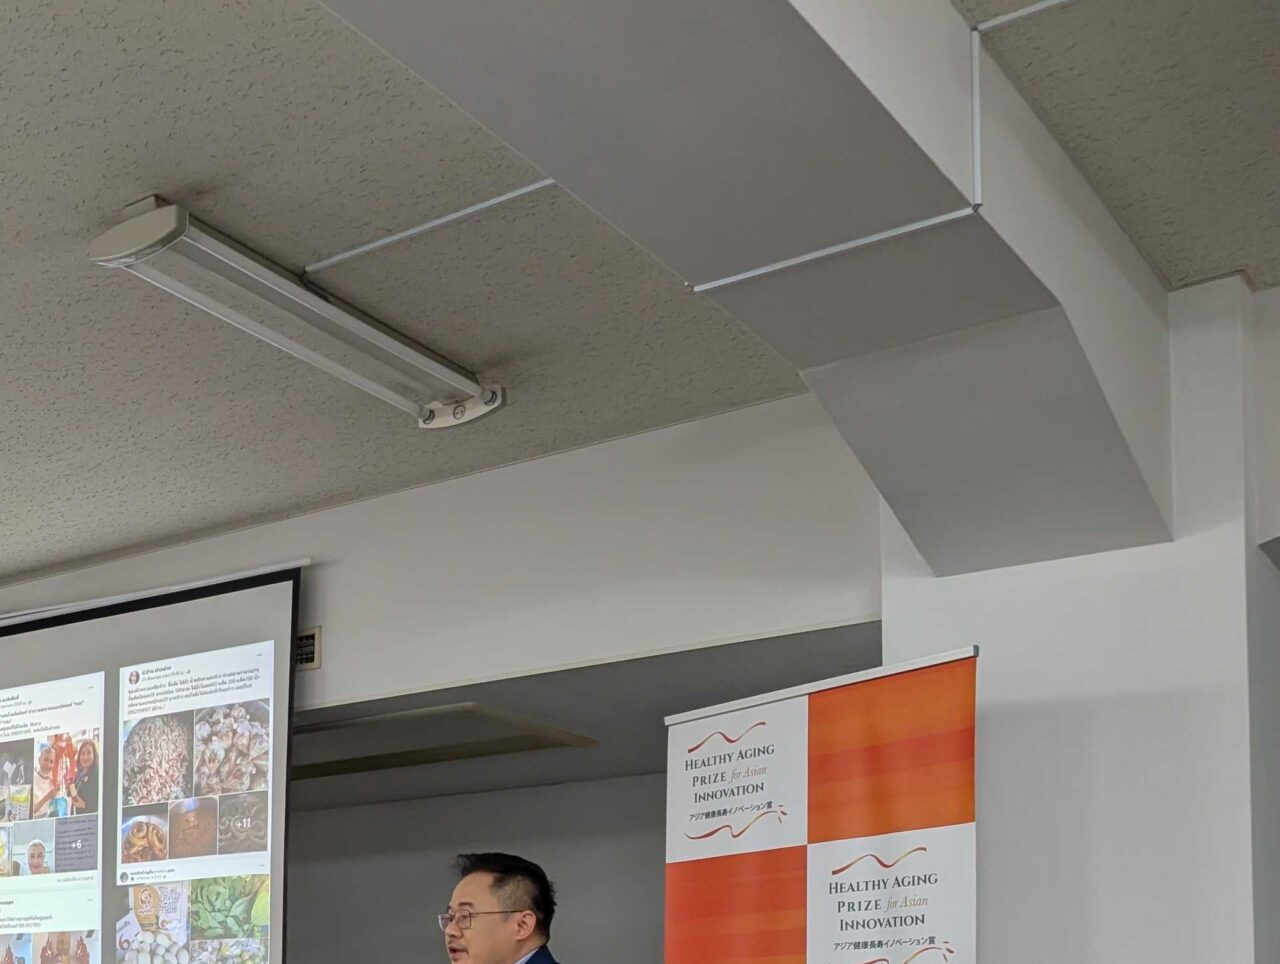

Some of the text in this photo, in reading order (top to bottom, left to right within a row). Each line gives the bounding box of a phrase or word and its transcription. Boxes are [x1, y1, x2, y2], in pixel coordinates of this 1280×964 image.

[685, 744, 775, 771] HEALTHY AGING
[692, 766, 767, 787] PRIZE for Asian
[694, 782, 764, 804] INNOVATION
[688, 801, 773, 822] アジア健康長寿イノベーション賞
[235, 818, 251, 828] +11
[71, 840, 82, 849] +6
[828, 873, 938, 895] HEALTHY AGING
[837, 895, 928, 913] PRIZE for Asian
[840, 914, 925, 932] INNOVATION
[833, 936, 936, 951] アジア健康長寿イノベーション賞
